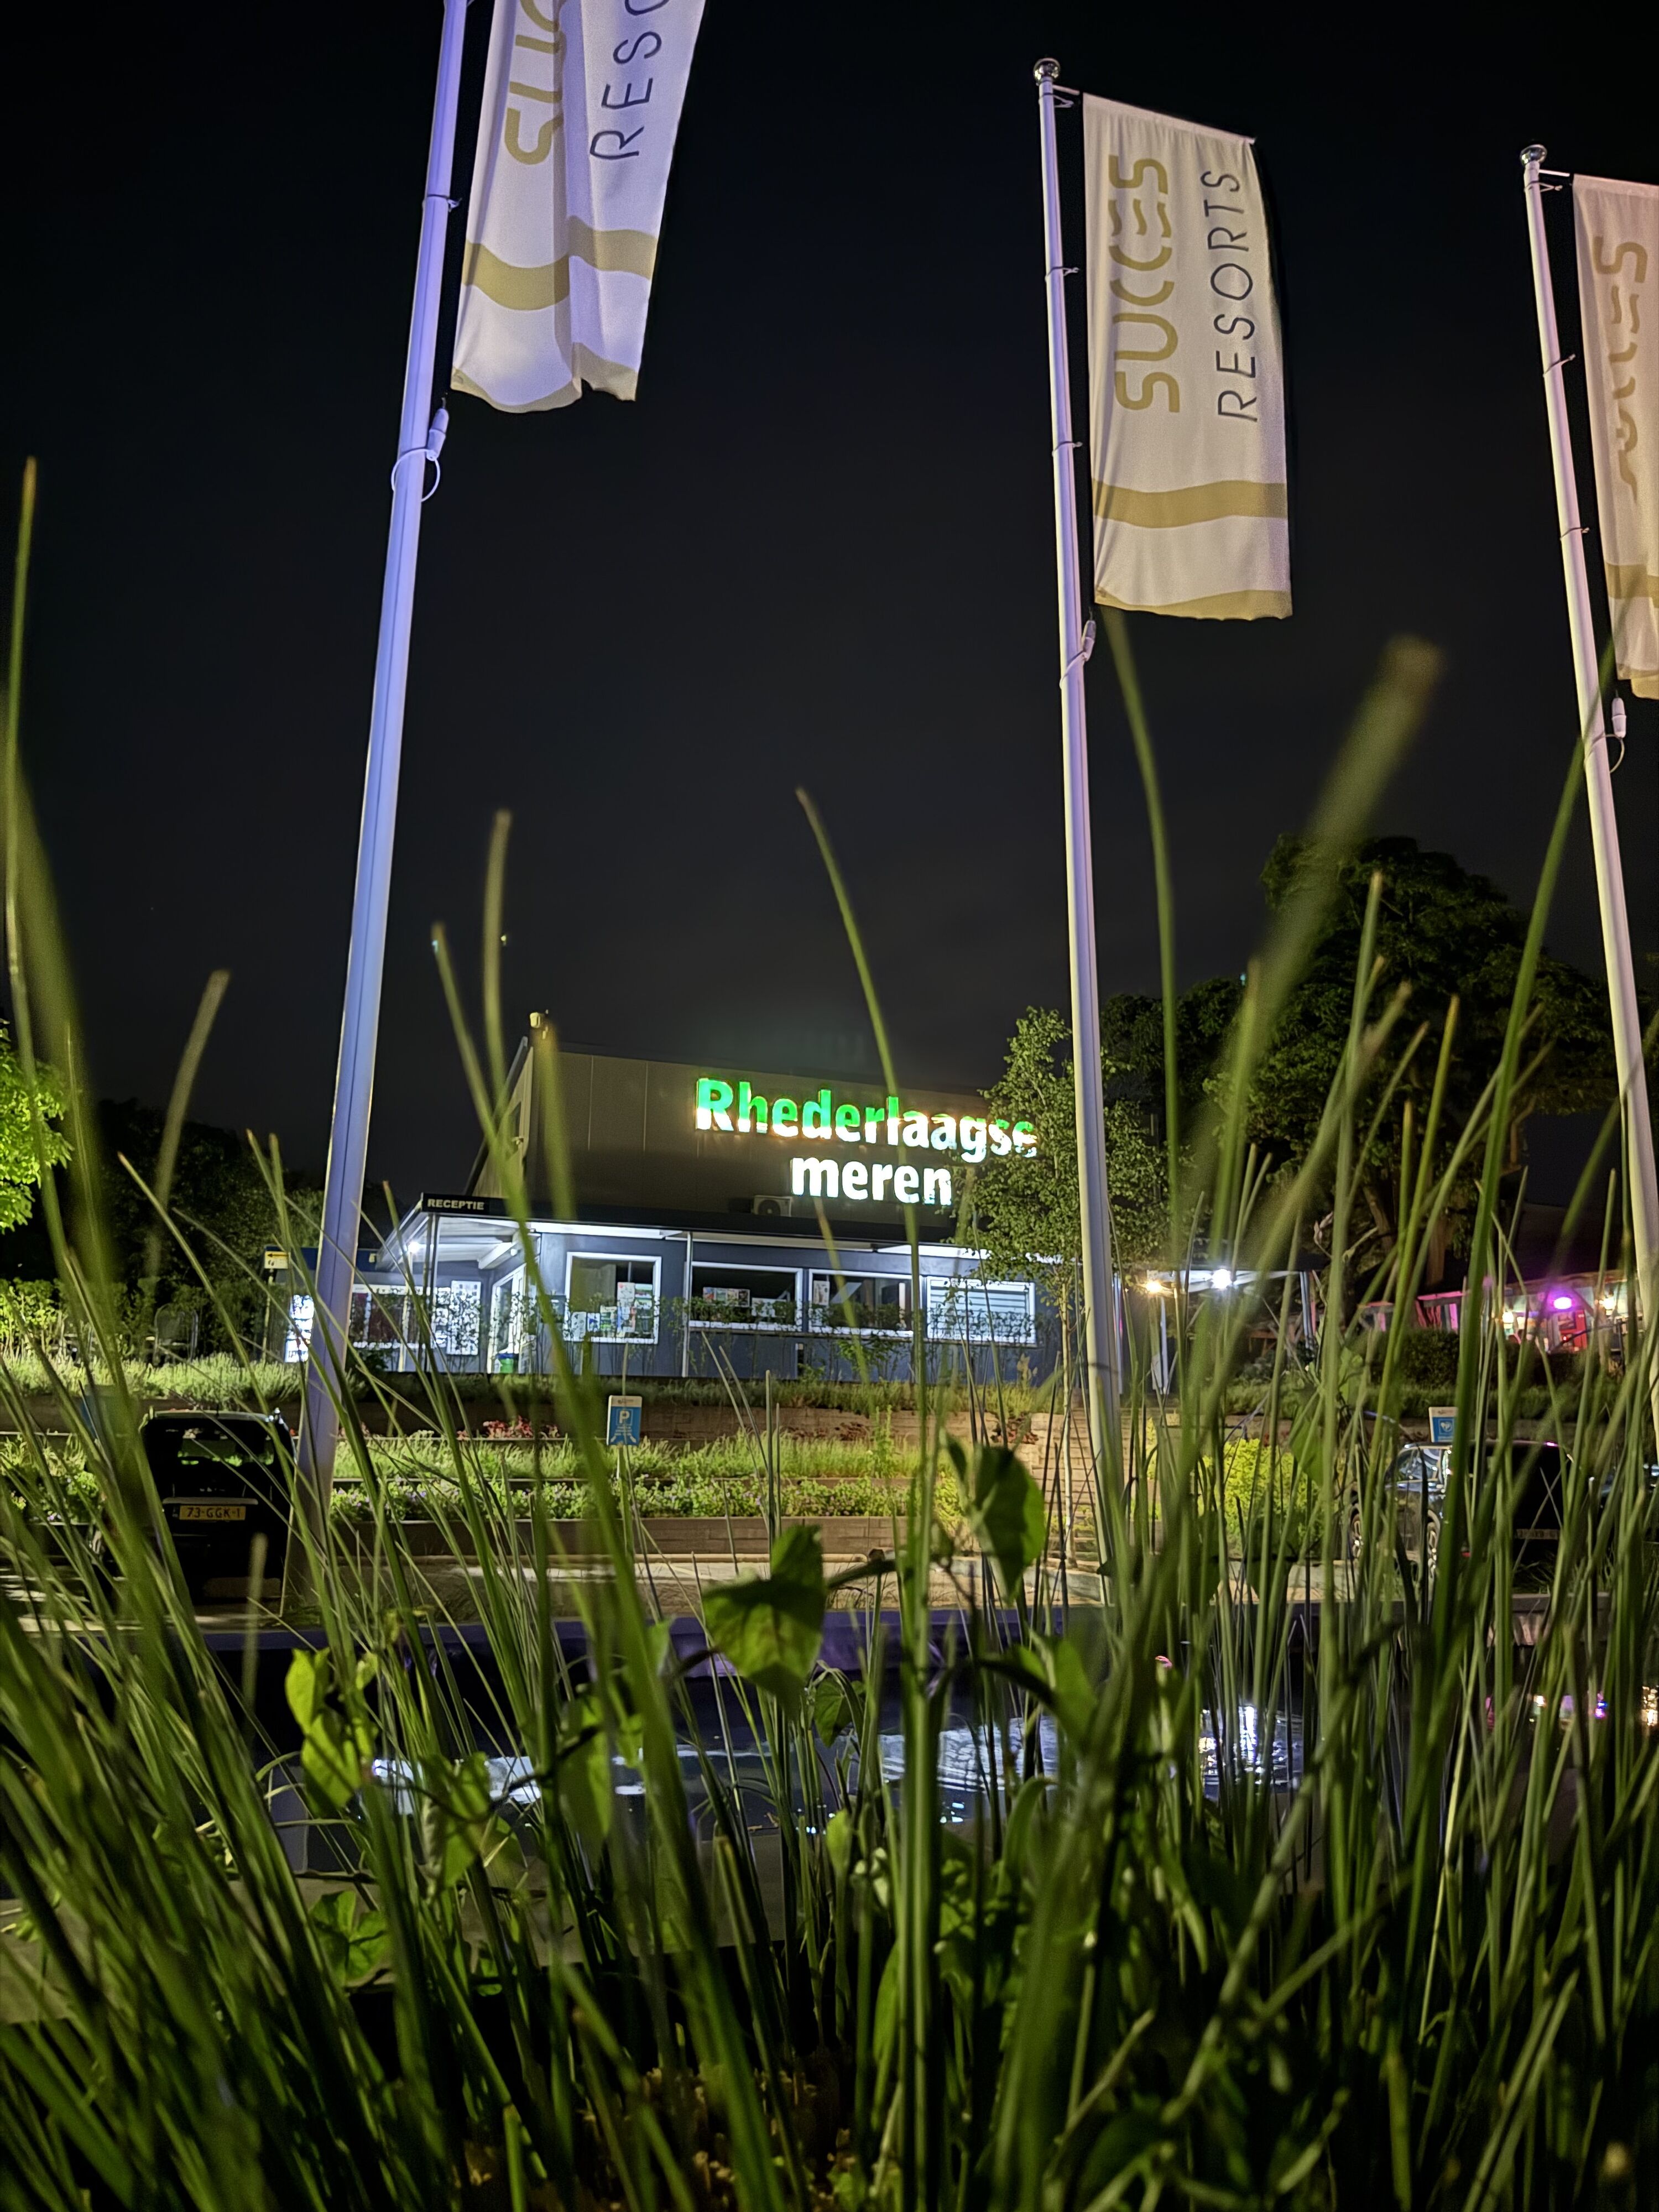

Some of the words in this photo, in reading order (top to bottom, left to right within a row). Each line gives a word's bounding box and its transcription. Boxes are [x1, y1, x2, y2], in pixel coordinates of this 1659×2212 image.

[1108, 154, 1180, 413] SUCCES
[1200, 170, 1258, 422] RESORTS
[696, 1077, 1038, 1164] Rhederlaagse
[427, 1198, 484, 1211] RECEPTIE
[791, 1157, 952, 1206] meren
[619, 1410, 630, 1424] P
